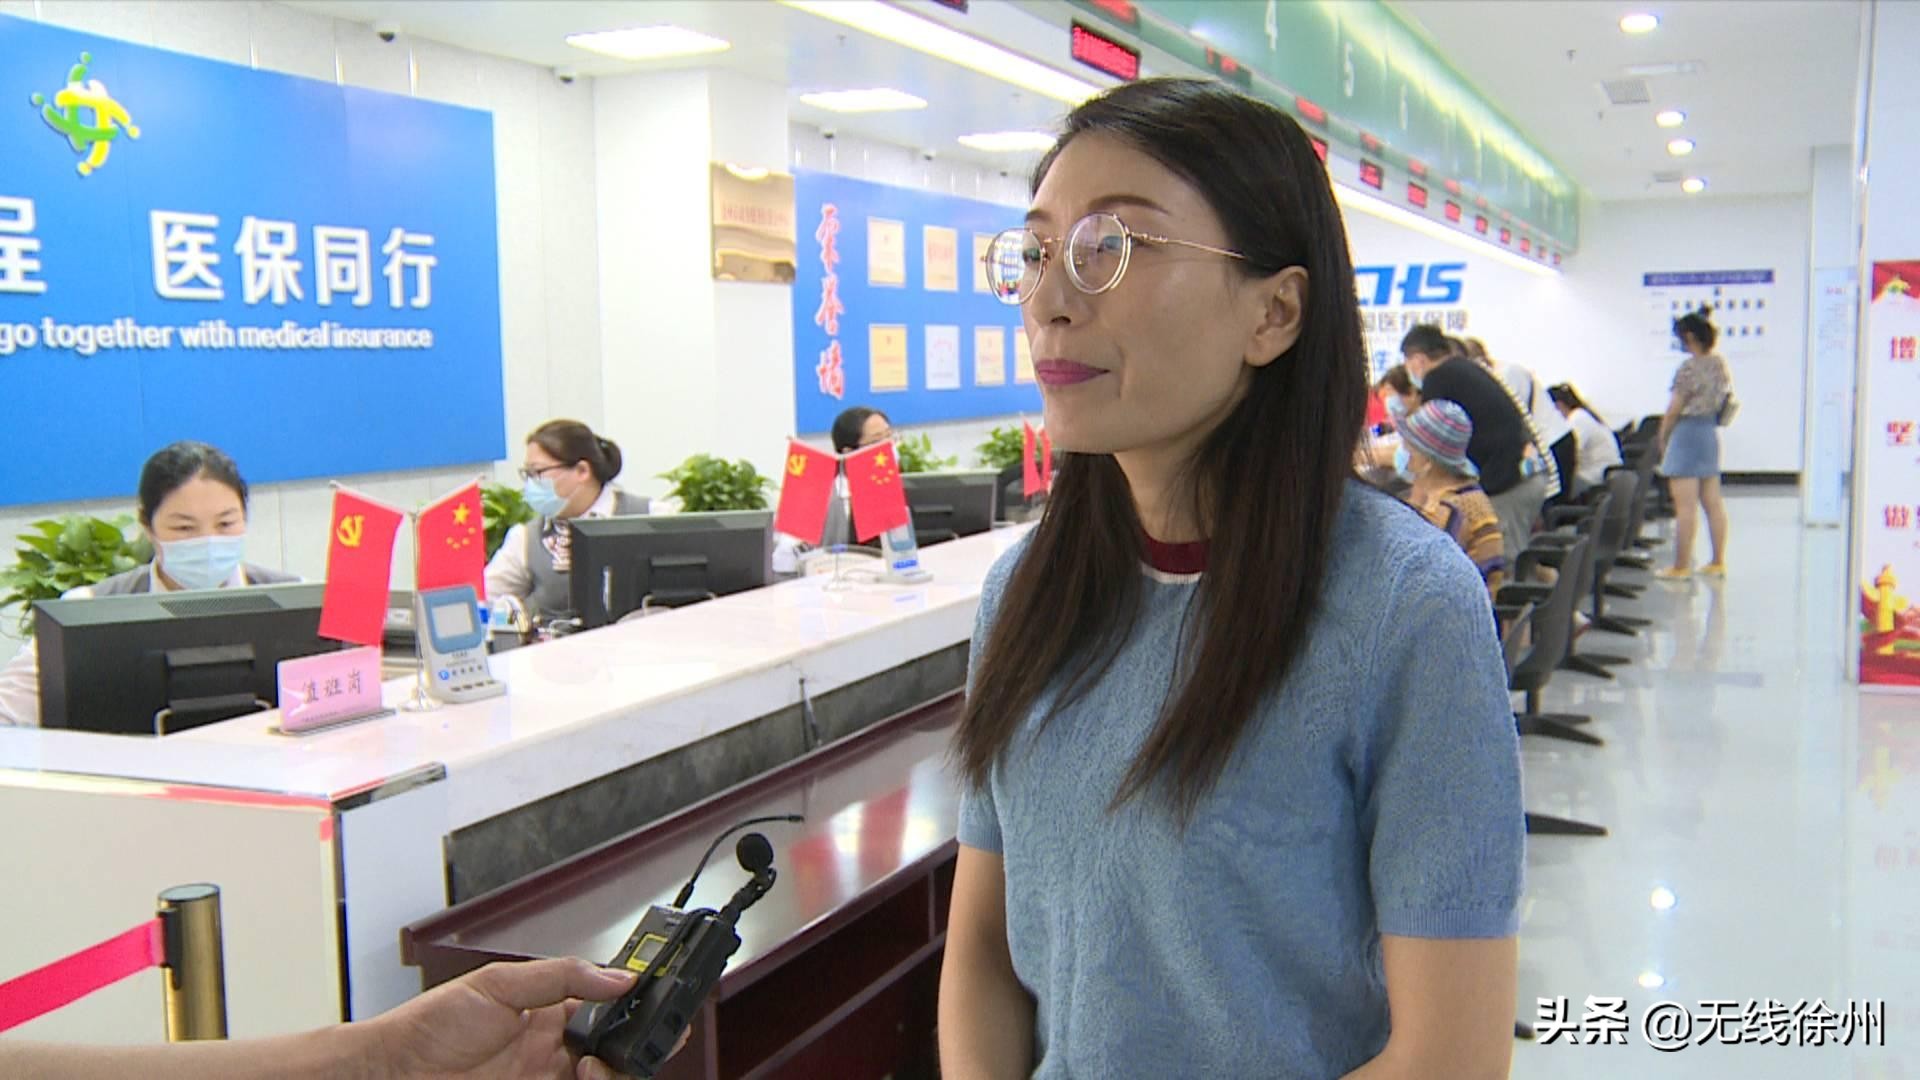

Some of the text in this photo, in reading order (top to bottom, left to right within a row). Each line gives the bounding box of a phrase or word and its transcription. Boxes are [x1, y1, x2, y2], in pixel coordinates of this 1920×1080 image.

[149, 209, 439, 309] 医保同行
[0, 316, 434, 355] go together with medical insurance
[302, 668, 362, 705] 值班岗
